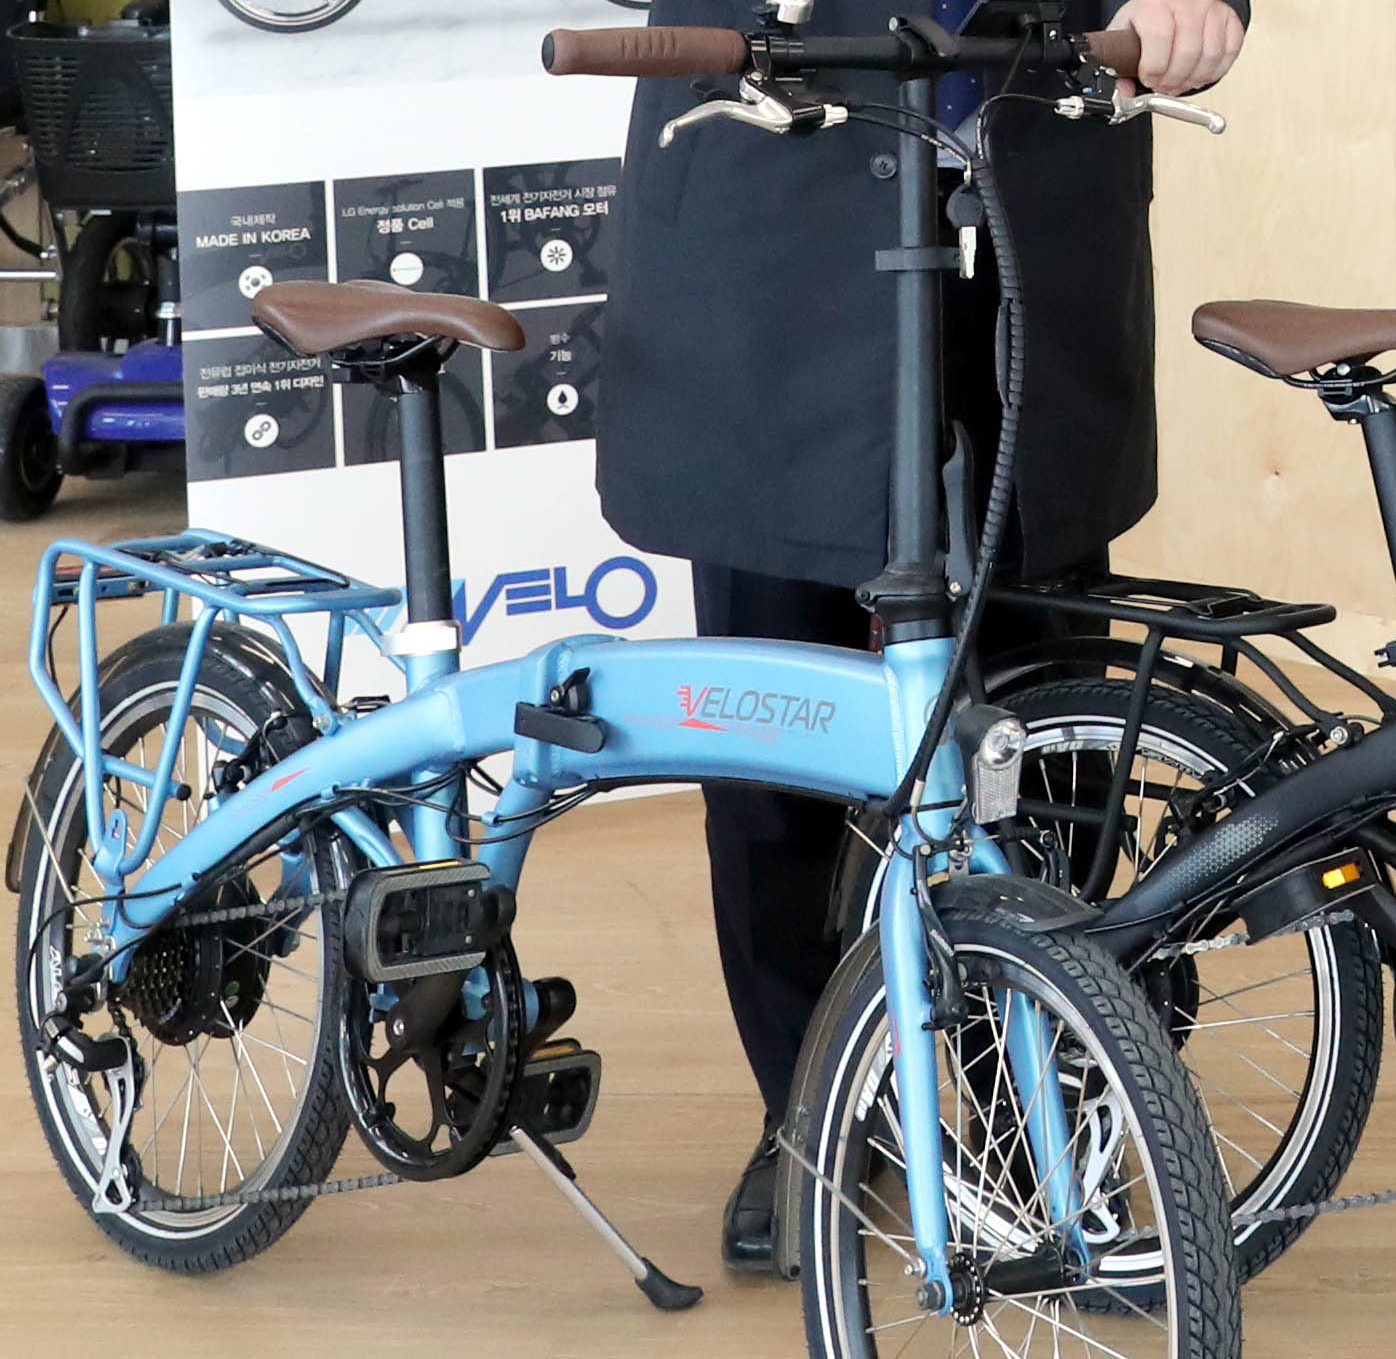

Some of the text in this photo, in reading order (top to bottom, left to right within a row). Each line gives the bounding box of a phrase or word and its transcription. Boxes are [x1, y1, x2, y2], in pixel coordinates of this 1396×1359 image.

[500, 201, 609, 223] 1위 BAFANG 모터
[407, 216, 435, 231] Cell
[196, 227, 312, 249] MADE IN KOREA
[676, 684, 836, 734] VELOSTAR
